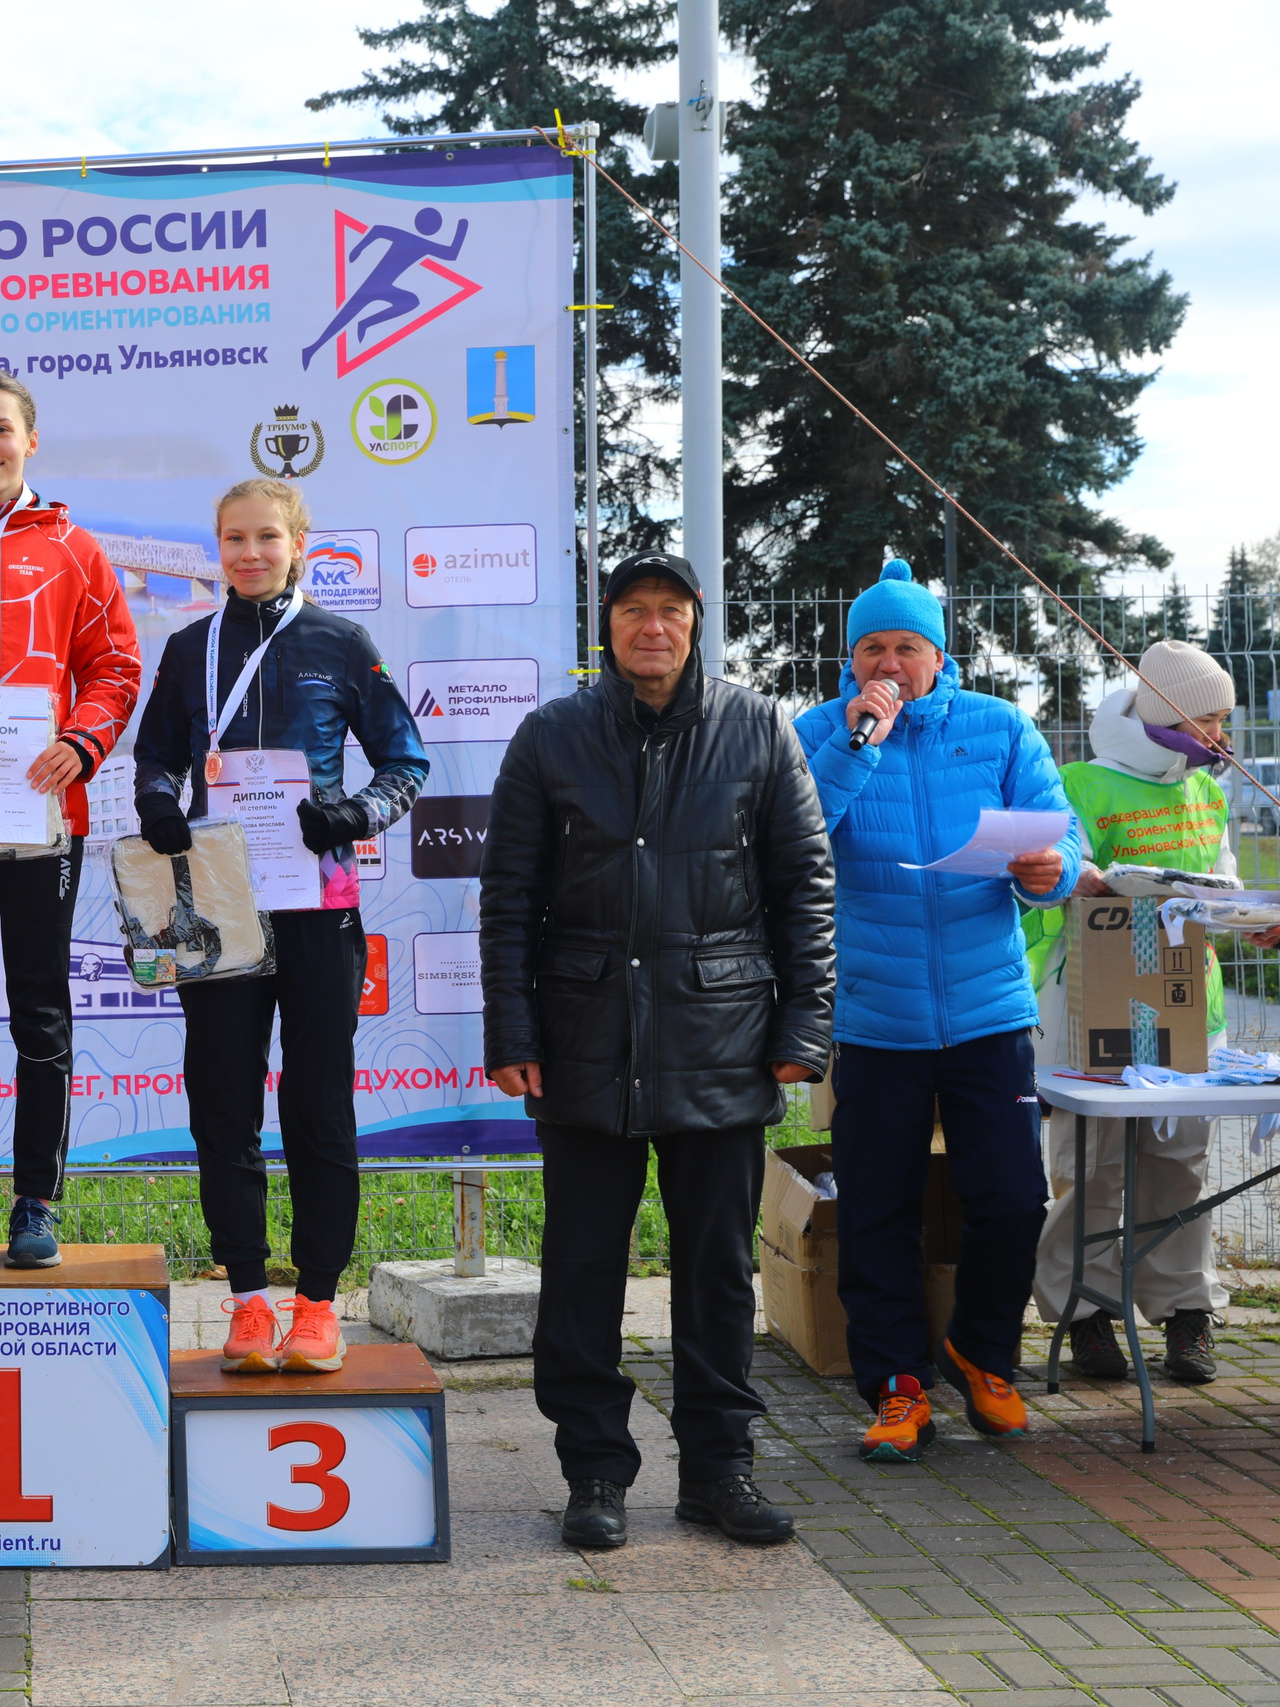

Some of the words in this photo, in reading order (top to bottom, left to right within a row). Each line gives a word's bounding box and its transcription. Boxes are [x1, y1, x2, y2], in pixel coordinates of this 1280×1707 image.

[42, 208, 267, 258] РОССИИ
[25, 302, 270, 333] ОРИЕНТИРОВАНИЯ
[27, 352, 112, 380] город
[118, 345, 269, 370] Ульяновск
[266, 423, 308, 433] ТРИУМФ
[369, 441, 419, 452] УЛСПОРТ
[444, 548, 530, 569] azimut
[19, 569, 34, 577] TEAM
[444, 575, 471, 583] ОТЕЛЬ
[321, 587, 378, 598] ПОДДЕРЖКИ
[345, 598, 380, 606] ПРОЕКТОВ
[448, 684, 508, 694] МЕТАЛЛО
[448, 692, 536, 705] ПРОФИЛЬНЫЙ
[448, 707, 490, 717] ЗАВОД
[232, 790, 285, 804] ДИПЛОМ
[1096, 806, 1171, 830] Федерация
[1111, 835, 1196, 858] Ульяновской
[1173, 990, 1185, 998] 12
[1098, 1038, 1113, 1058] L
[352, 1067, 458, 1095] ДУХОМ
[31, 1341, 117, 1356] ОБЛАСТИ
[266, 1420, 352, 1533] 3
